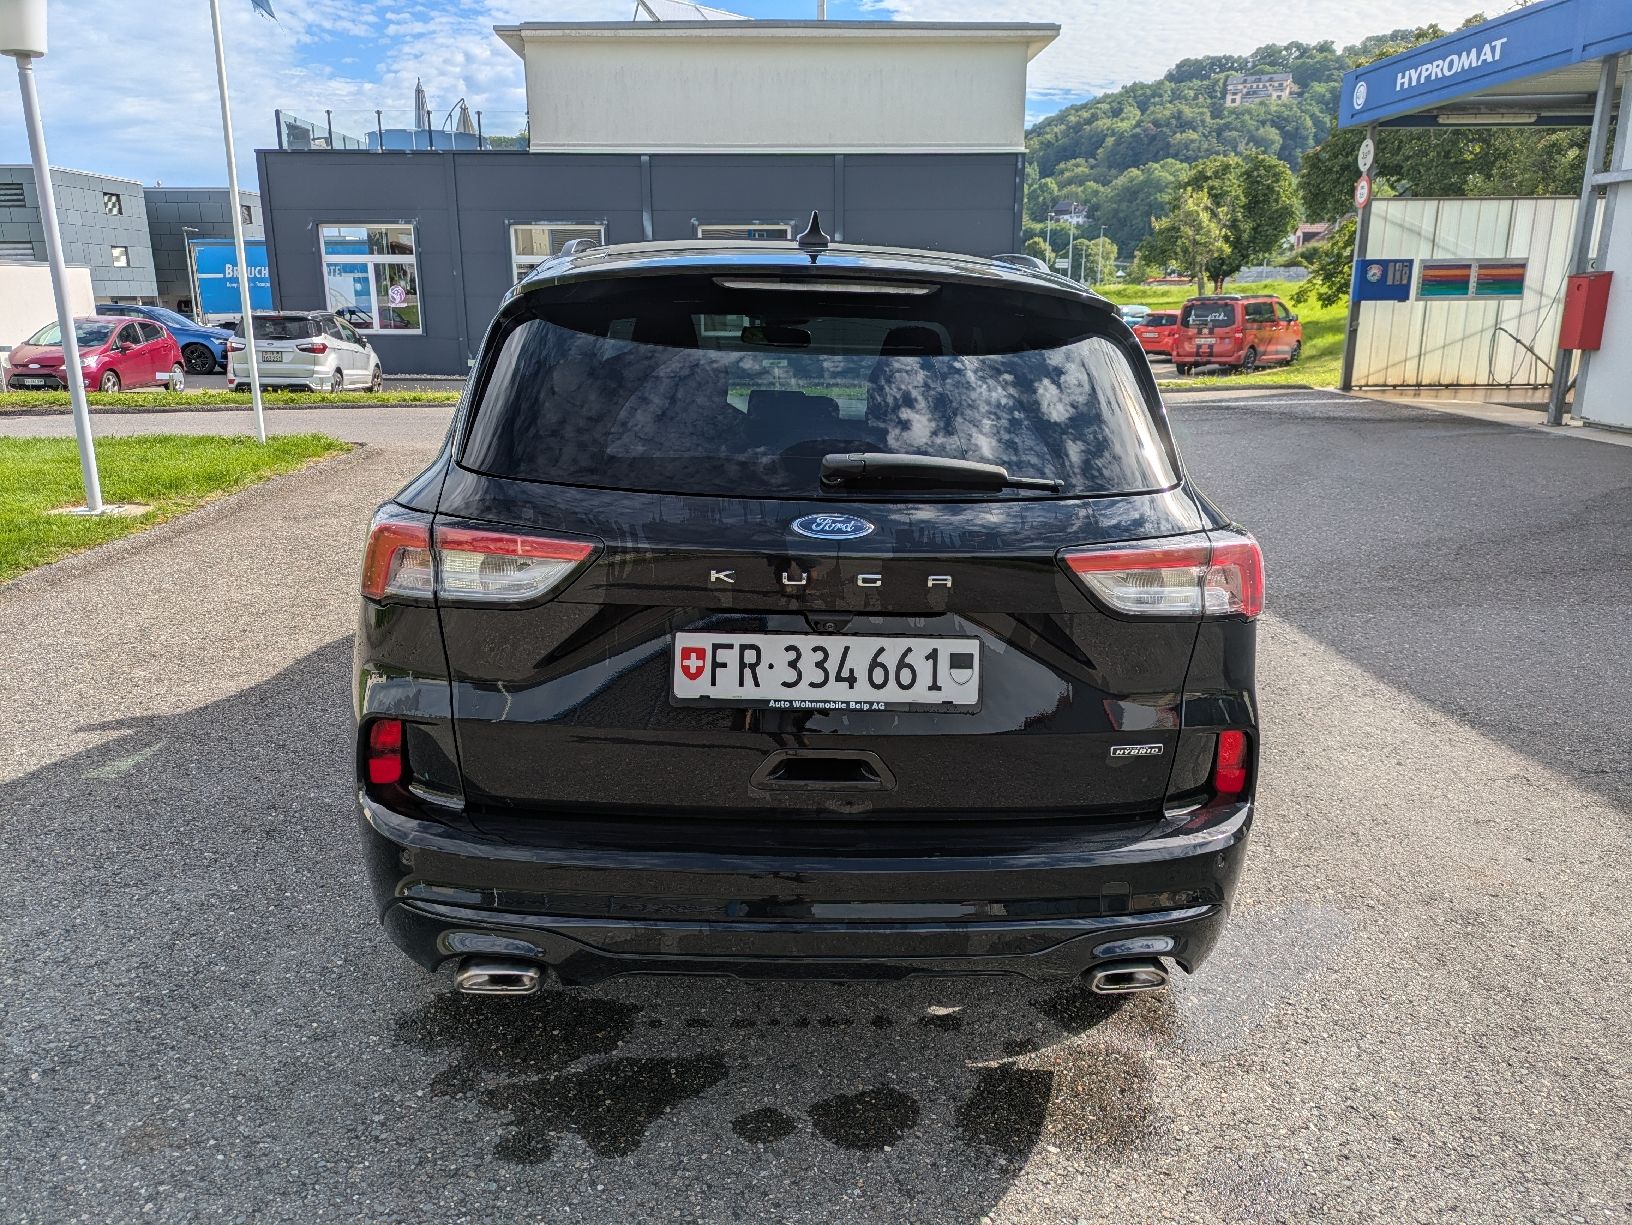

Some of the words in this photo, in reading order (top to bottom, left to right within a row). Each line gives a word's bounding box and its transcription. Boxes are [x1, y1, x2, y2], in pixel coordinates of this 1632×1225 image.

[1395, 37, 1508, 91] HYPROMAT
[225, 263, 269, 278] BRUCH
[811, 516, 855, 532] Ford
[710, 569, 952, 588] KUGA
[769, 700, 790, 708] Auto
[793, 700, 847, 709] Wohnmobile
[872, 702, 885, 710] AG
